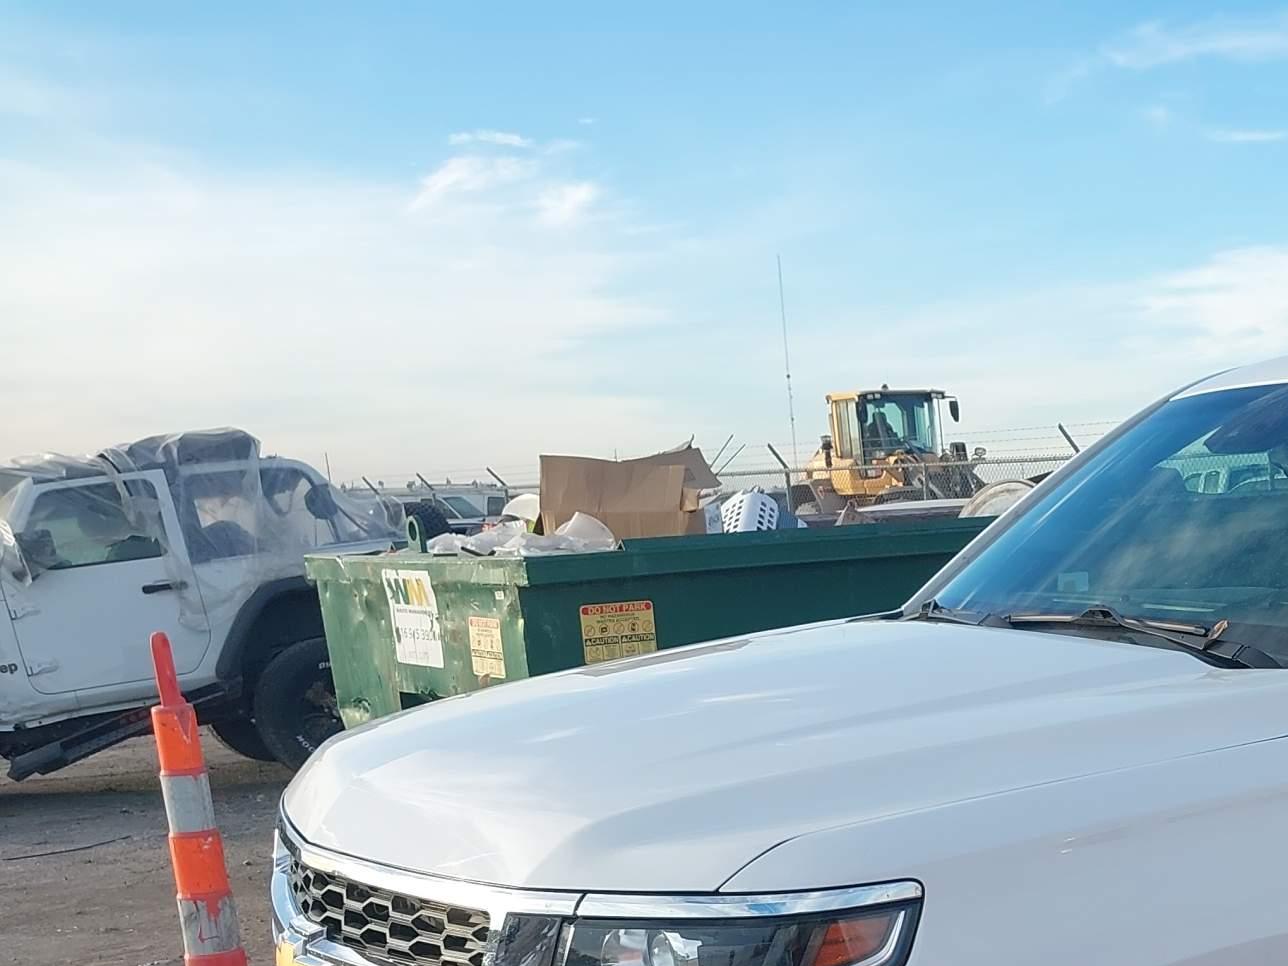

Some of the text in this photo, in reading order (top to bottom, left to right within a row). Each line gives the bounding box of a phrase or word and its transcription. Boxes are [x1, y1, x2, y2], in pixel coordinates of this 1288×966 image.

[589, 602, 646, 615] DO NOT PARK
[592, 635, 619, 646] CAUTION
[627, 632, 655, 642] CAUTION
